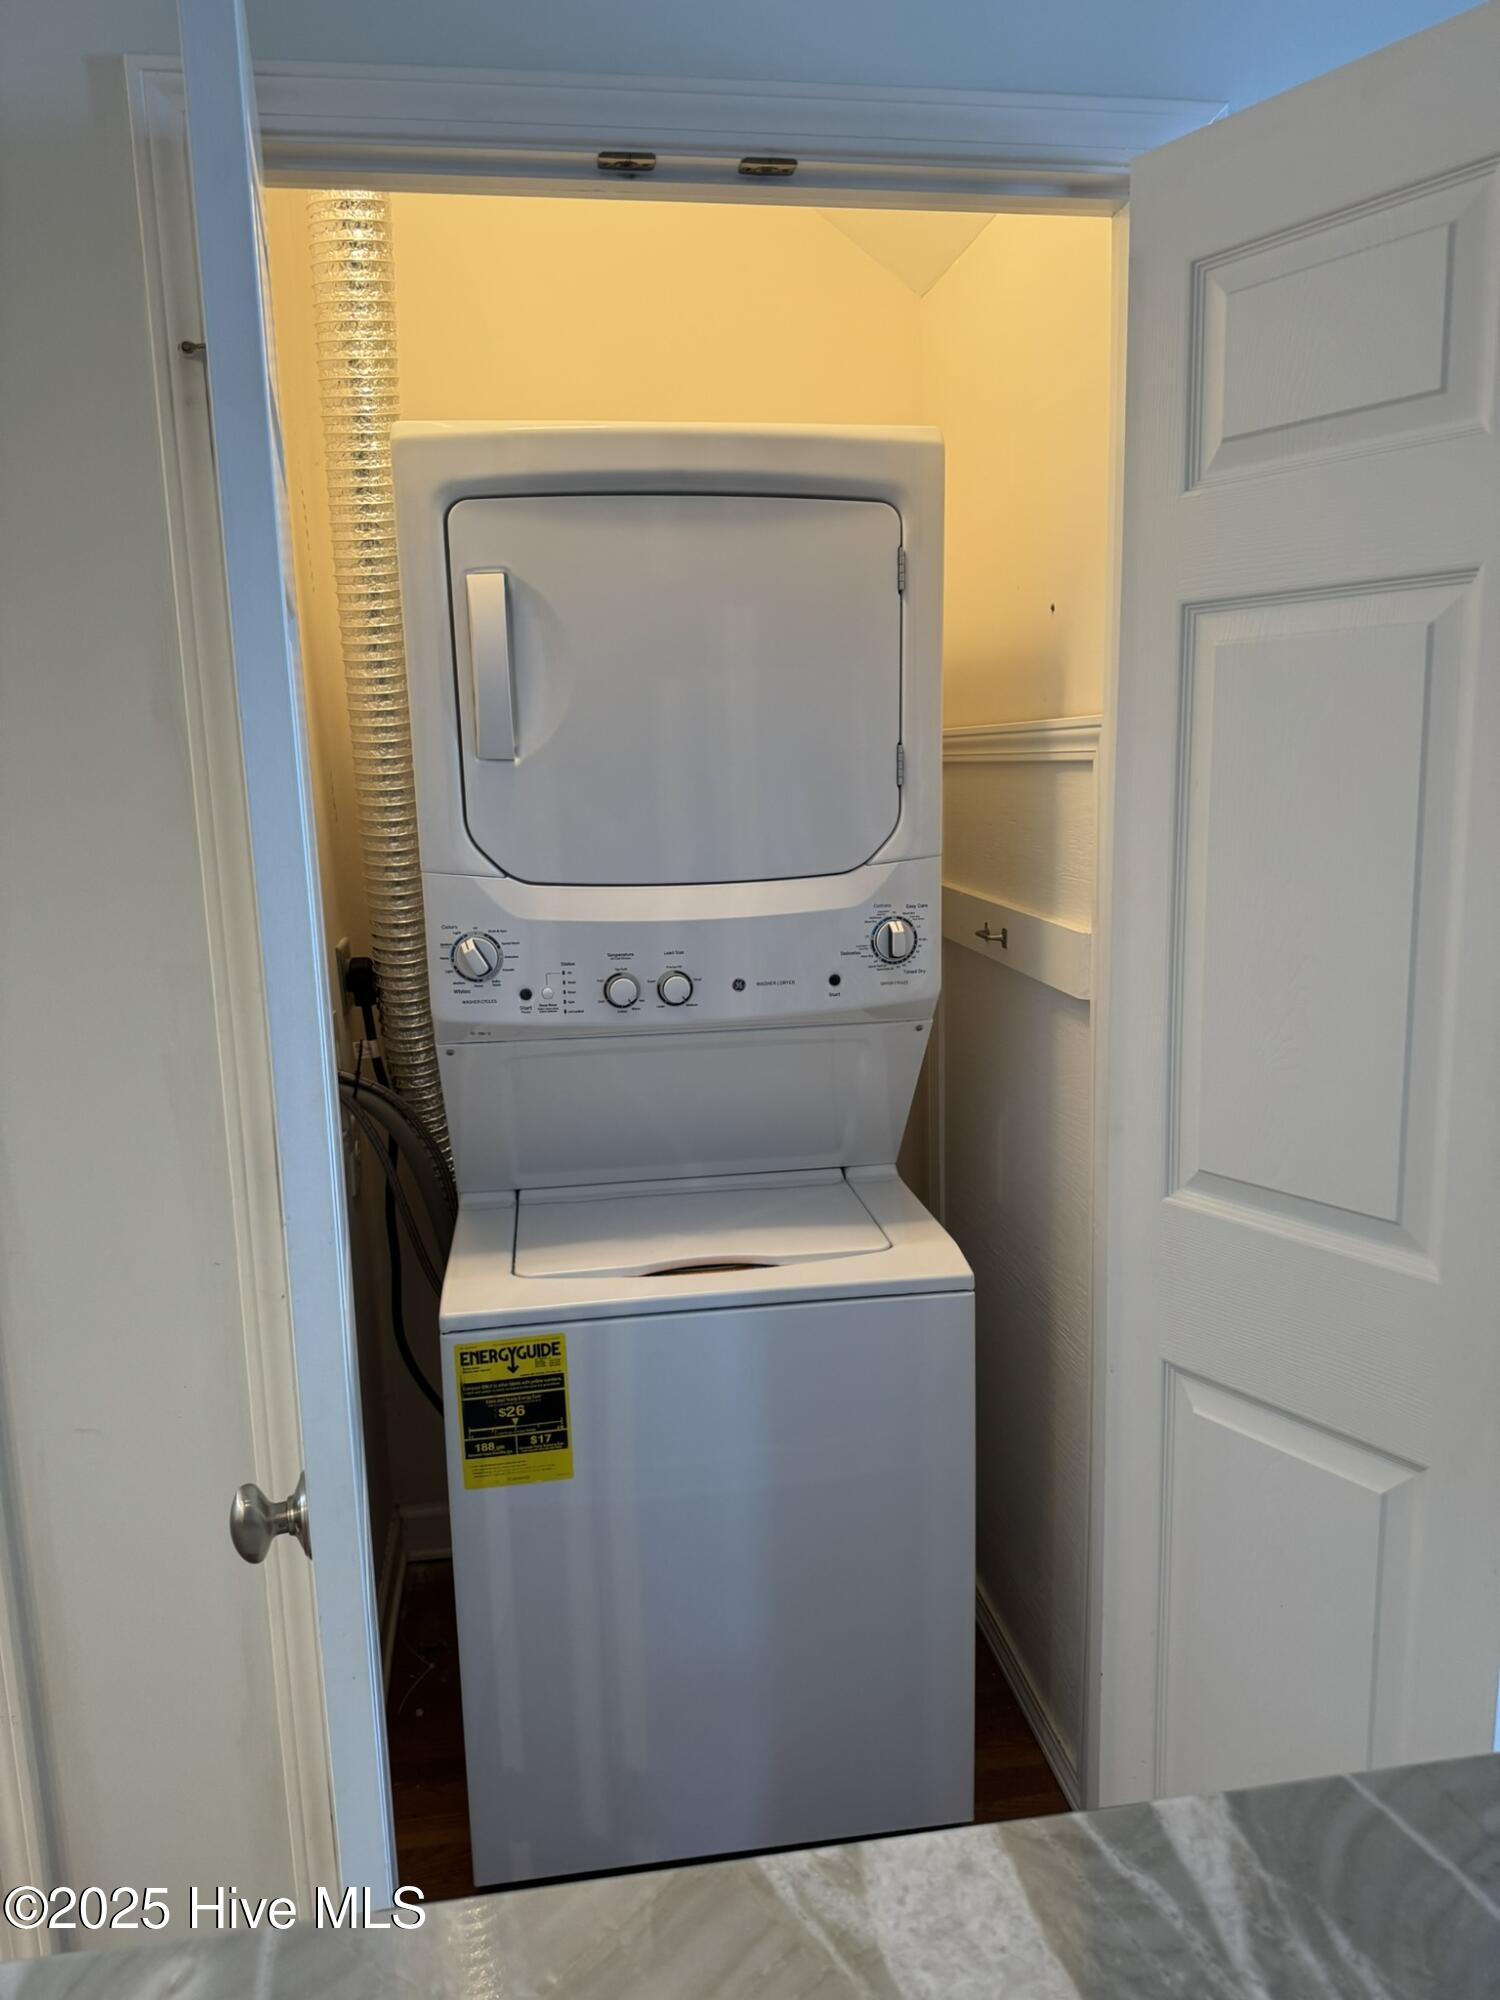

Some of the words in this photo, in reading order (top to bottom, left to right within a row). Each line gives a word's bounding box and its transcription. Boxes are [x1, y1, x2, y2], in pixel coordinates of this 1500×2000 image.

[459, 1341, 561, 1367] ENERGYGUIDE
[498, 1405, 526, 1418] $26
[529, 1434, 552, 1445] $17
[474, 1442, 495, 1453] 188
